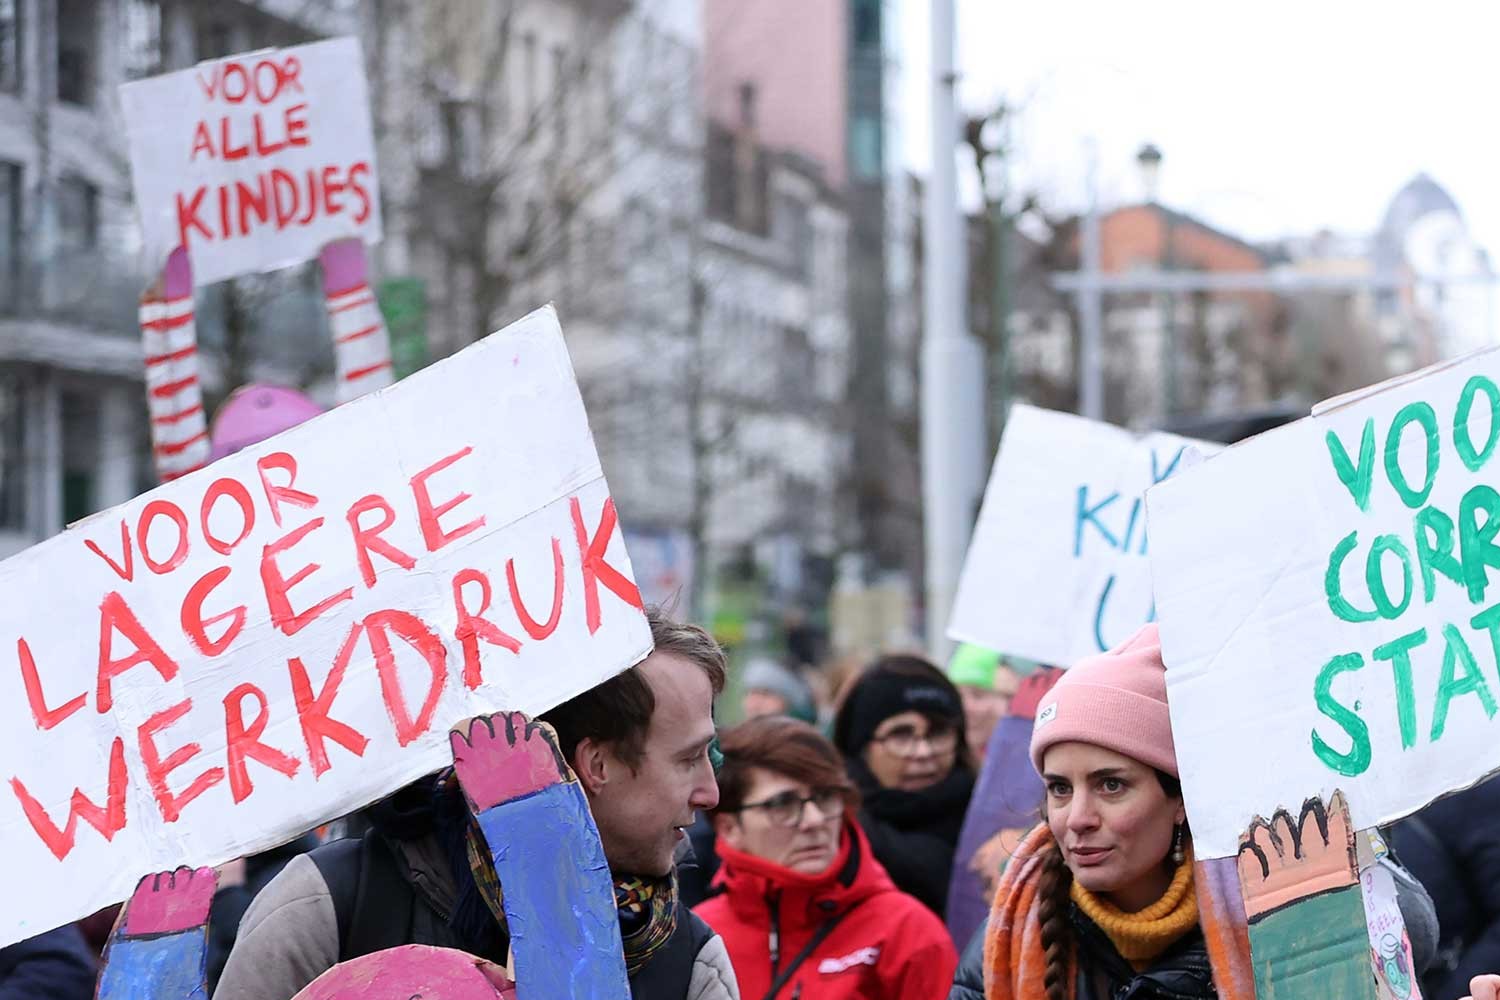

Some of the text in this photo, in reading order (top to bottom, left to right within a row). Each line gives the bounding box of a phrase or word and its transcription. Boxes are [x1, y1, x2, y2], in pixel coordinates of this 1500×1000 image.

[190, 102, 311, 161] ALLE
[196, 55, 305, 104] VOOR
[175, 162, 371, 250] KINDJES
[83, 451, 319, 582] VOOR
[16, 446, 487, 731] LAGERE
[7, 496, 644, 862] WERKDRUK
